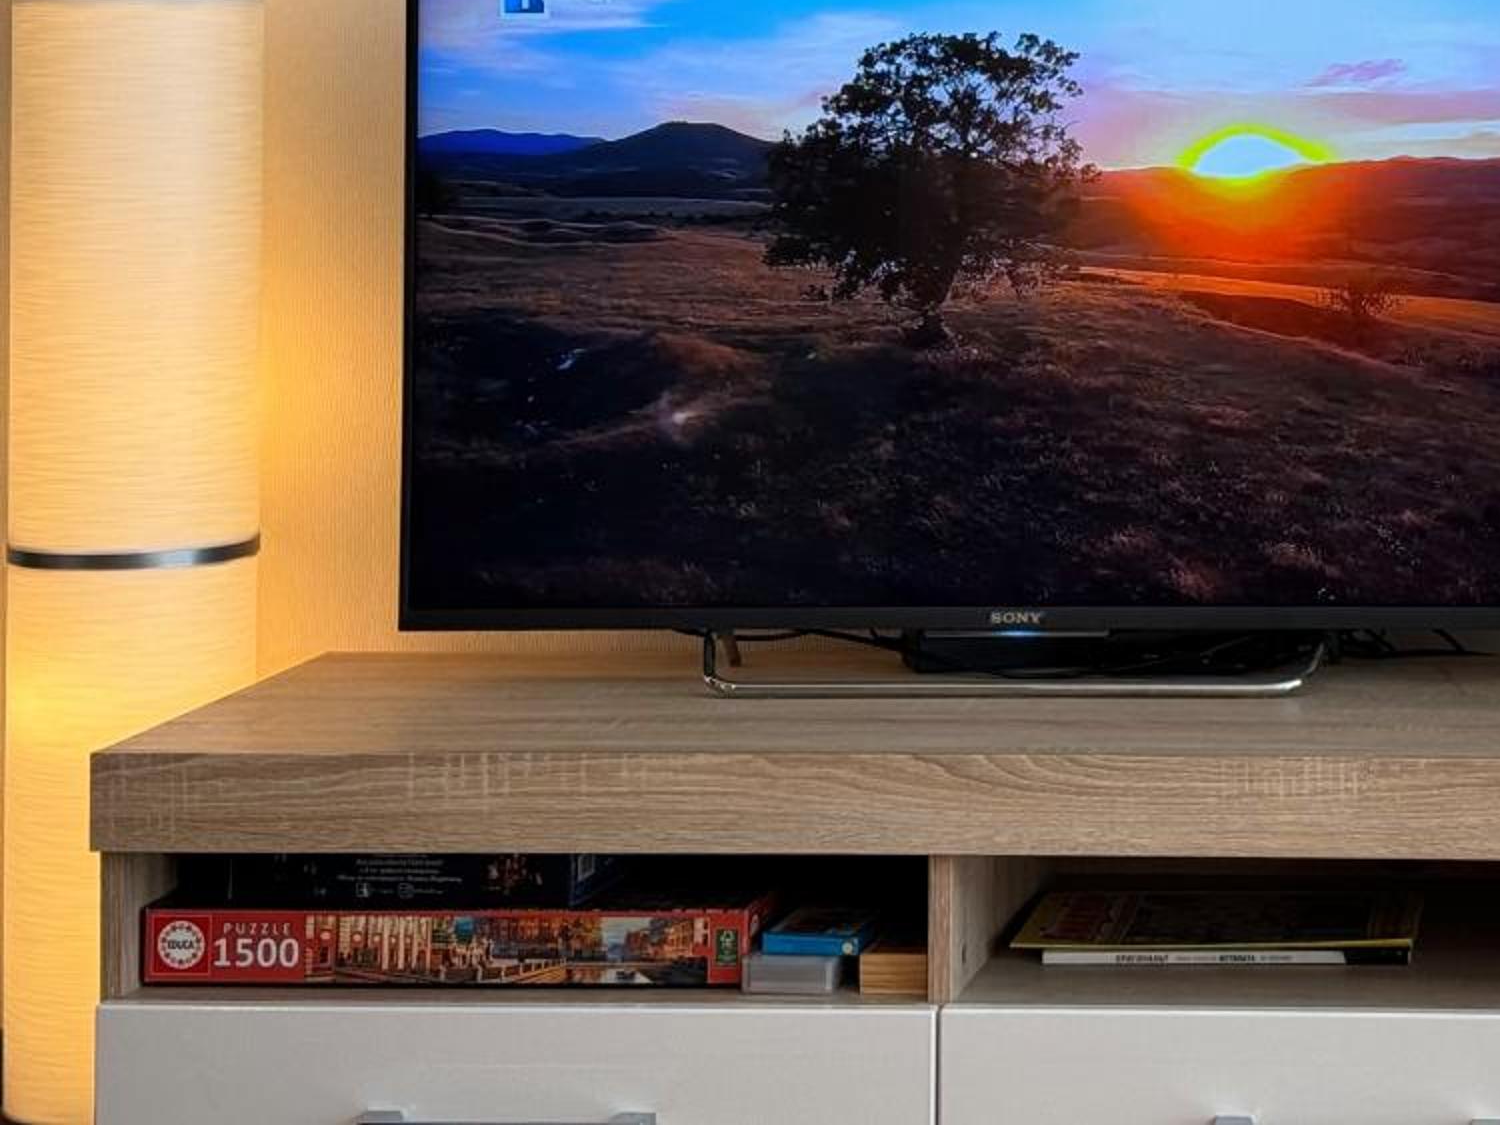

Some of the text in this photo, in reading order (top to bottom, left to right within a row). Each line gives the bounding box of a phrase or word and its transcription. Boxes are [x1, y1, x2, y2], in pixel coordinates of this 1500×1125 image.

[991, 611, 1041, 624] SONY
[223, 922, 291, 936] PUZZLE
[167, 940, 195, 951] EDUCA
[213, 938, 300, 968] 1500
